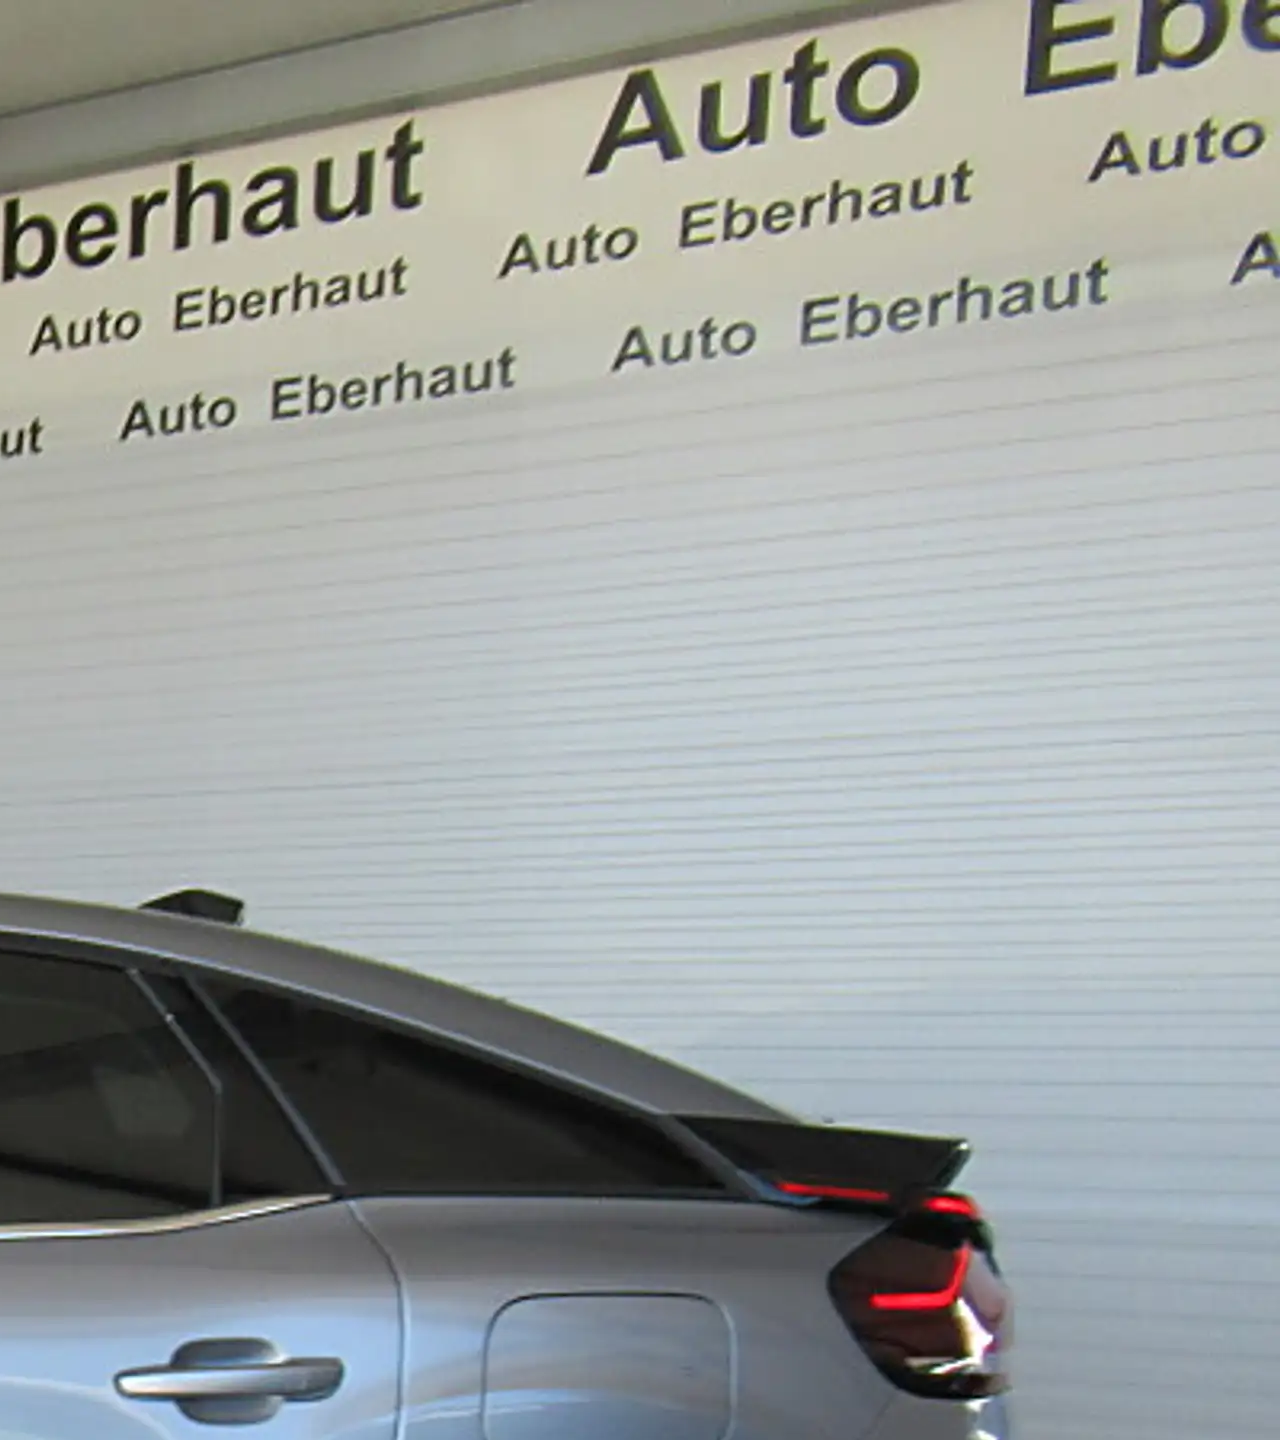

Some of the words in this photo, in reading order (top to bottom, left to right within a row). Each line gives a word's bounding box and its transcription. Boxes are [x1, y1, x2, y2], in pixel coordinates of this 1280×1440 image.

[585, 40, 920, 178] Auto
[1086, 118, 1266, 184] Auto
[497, 224, 639, 281] Auto
[678, 159, 974, 249] Eberhaut
[28, 307, 142, 357] Auto
[173, 255, 408, 333] Eberhaut
[611, 316, 757, 373] Auto
[800, 258, 1109, 347] Eberhaut
[119, 392, 237, 443] Auto
[271, 347, 516, 421] Eberhaut
